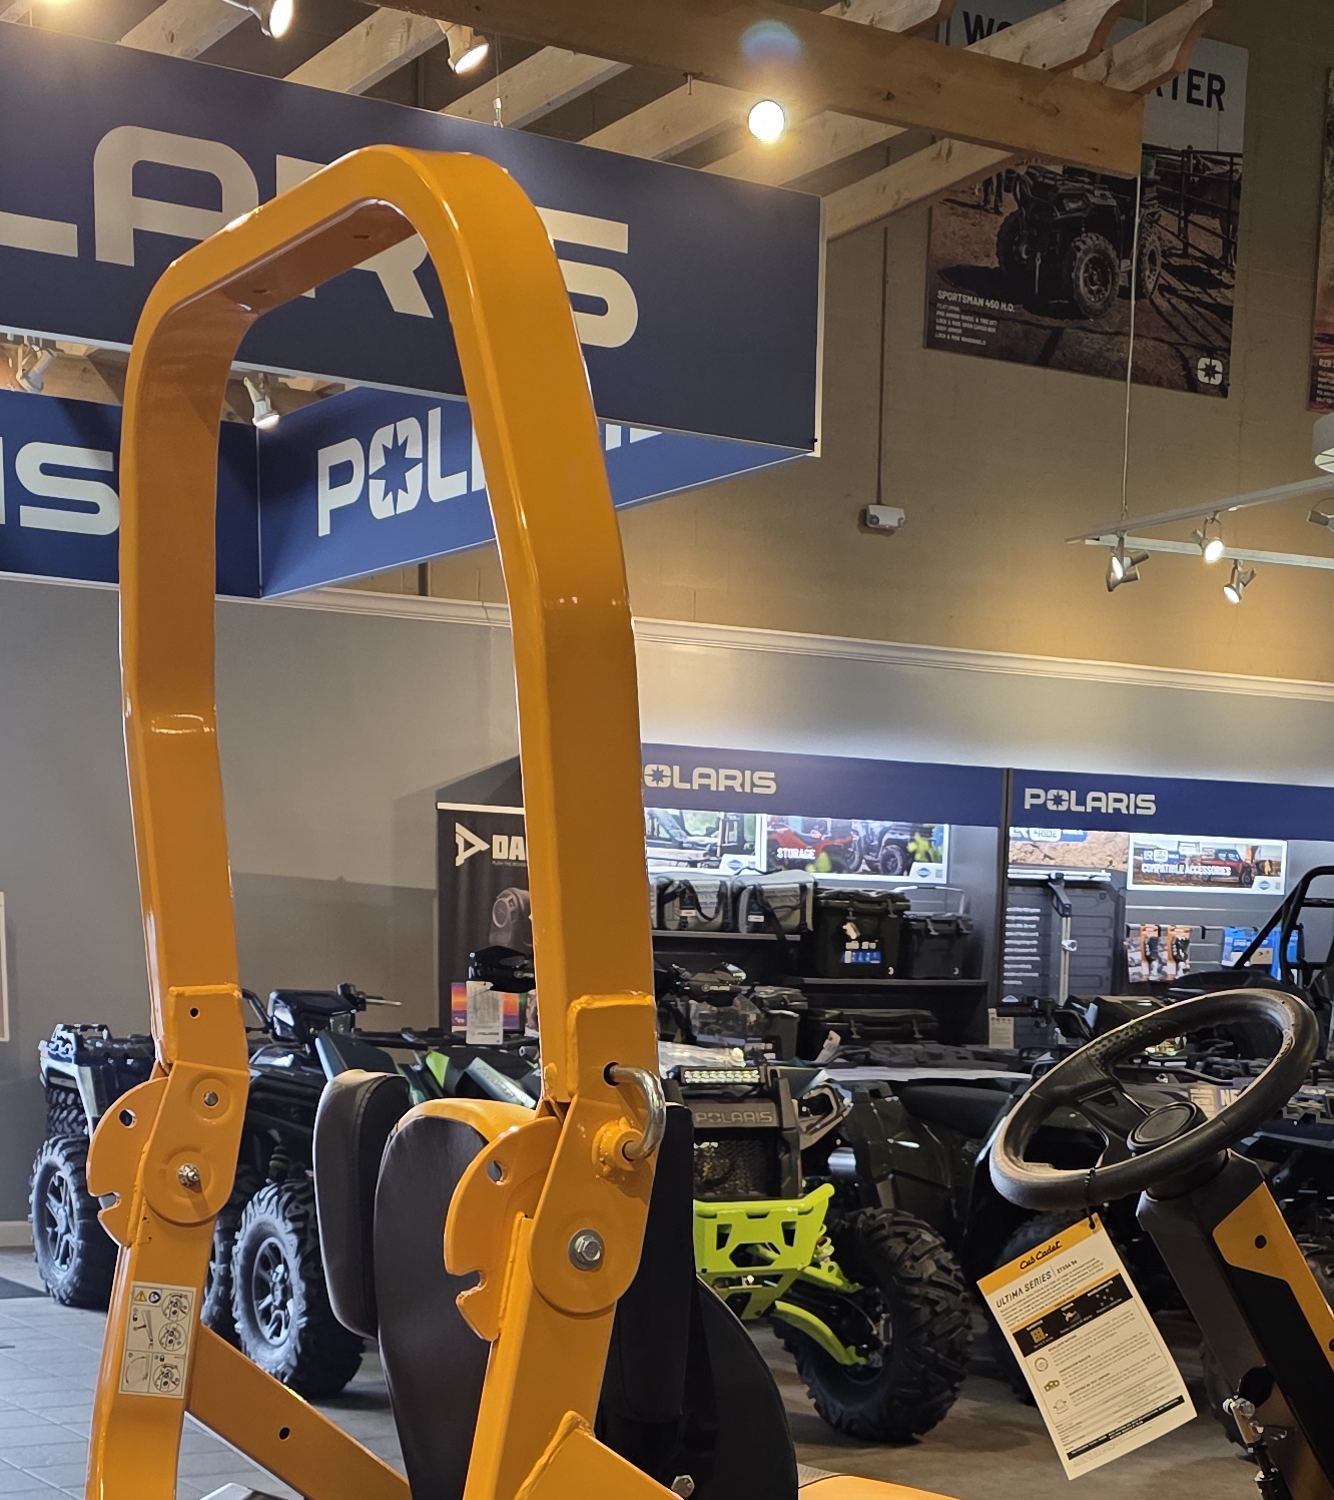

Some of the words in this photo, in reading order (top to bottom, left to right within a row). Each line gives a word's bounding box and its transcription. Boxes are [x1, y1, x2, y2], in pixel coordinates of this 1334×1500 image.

[937, 289, 984, 307] SPORTSMAN
[644, 764, 777, 795] OLARIS
[1024, 787, 1157, 817] POLARIS
[492, 835, 526, 861] DA
[777, 847, 816, 860] STORAGE
[1141, 863, 1186, 874] COMPATIBLE
[1220, 1089, 1242, 1106] NE
[695, 1111, 773, 1123] POLARIS
[1018, 1252, 1037, 1270] Cub
[1035, 1240, 1062, 1262] Cadet
[995, 1286, 1023, 1308] ULTIMA
[1023, 1270, 1053, 1292] SERIES
